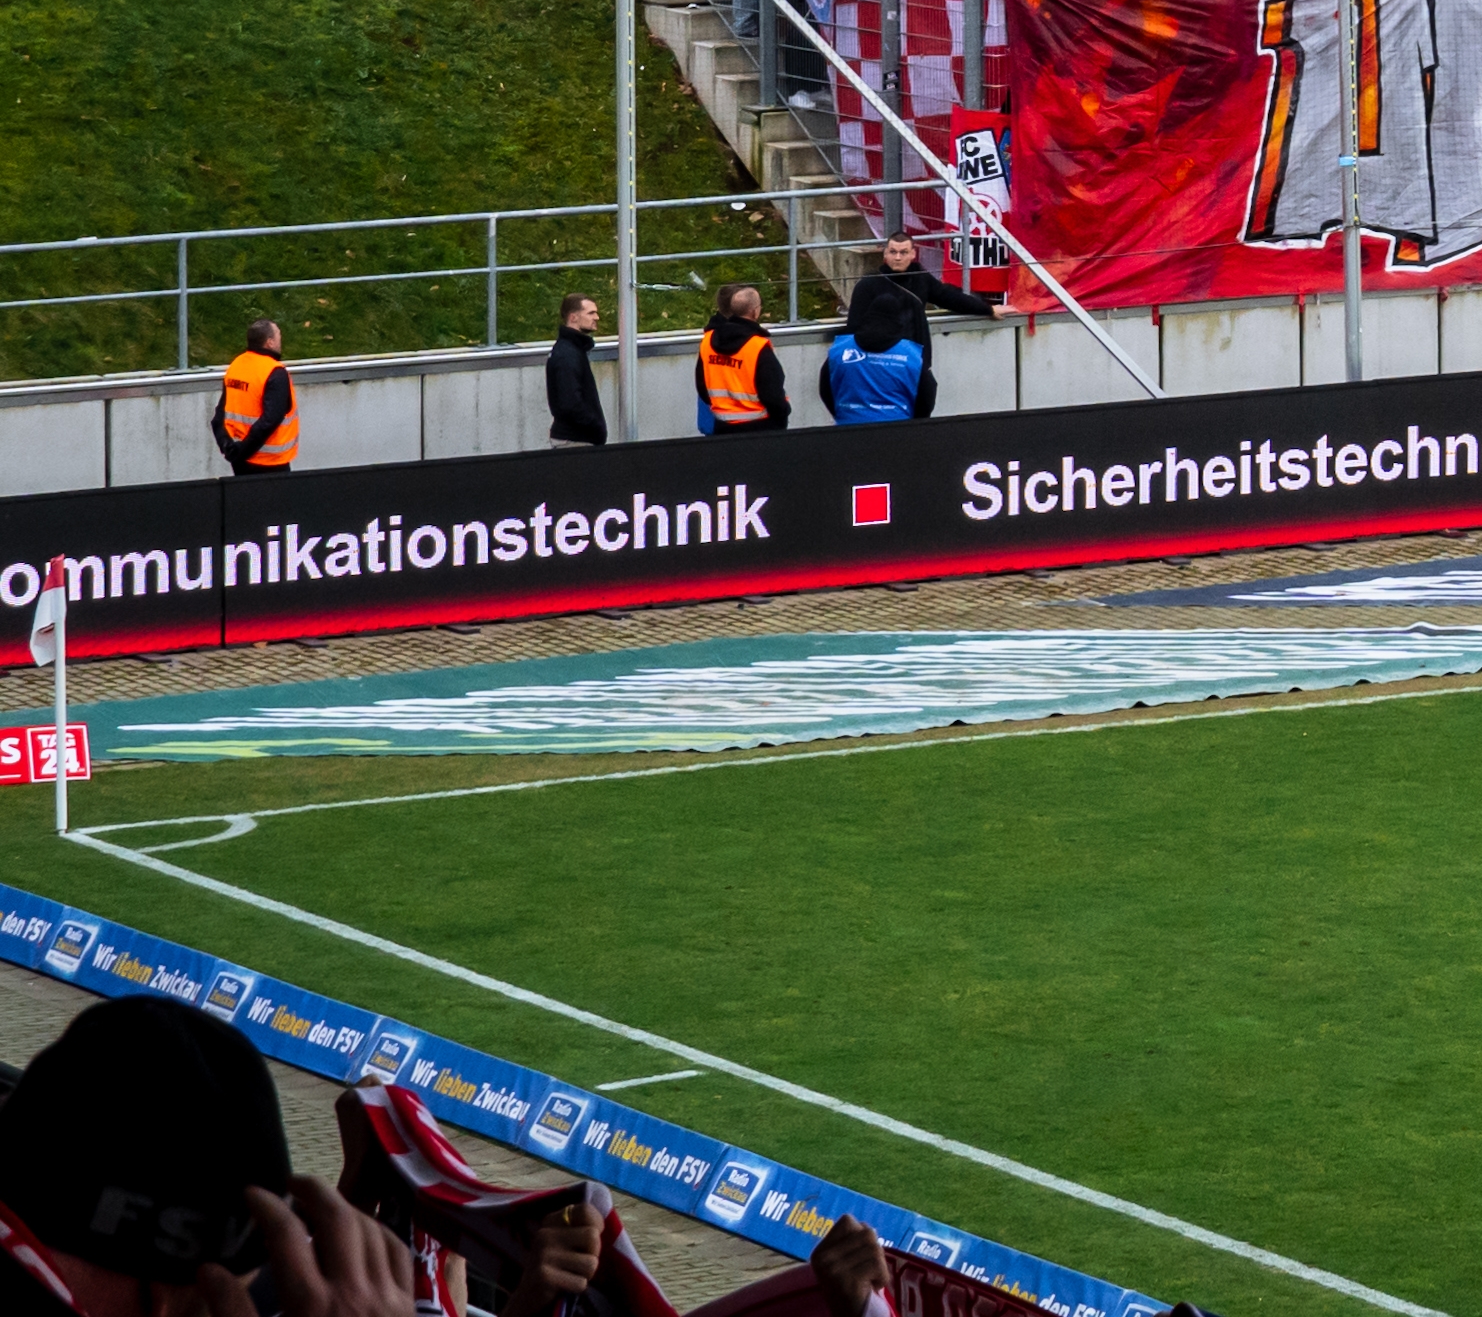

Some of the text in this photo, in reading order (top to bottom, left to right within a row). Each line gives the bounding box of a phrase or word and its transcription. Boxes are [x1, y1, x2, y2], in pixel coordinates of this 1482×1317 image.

[1, 910, 52, 943] den FSV
[92, 943, 118, 972] Wir
[112, 951, 153, 985] lieben
[150, 964, 203, 1003] Zwickau
[247, 996, 366, 1055] Wir lieben den FSV
[409, 1057, 531, 1123] Wir lieben Zwickau
[551, 1098, 573, 1117] Radio
[583, 1119, 612, 1150] Wir
[606, 1129, 653, 1168] lieben
[649, 1146, 681, 1179] den
[678, 1154, 711, 1188] FSV
[728, 1168, 750, 1188] Radio
[759, 1189, 791, 1222] Wir
[785, 1199, 835, 1238] lieben
[915, 1238, 942, 1262] Radio
